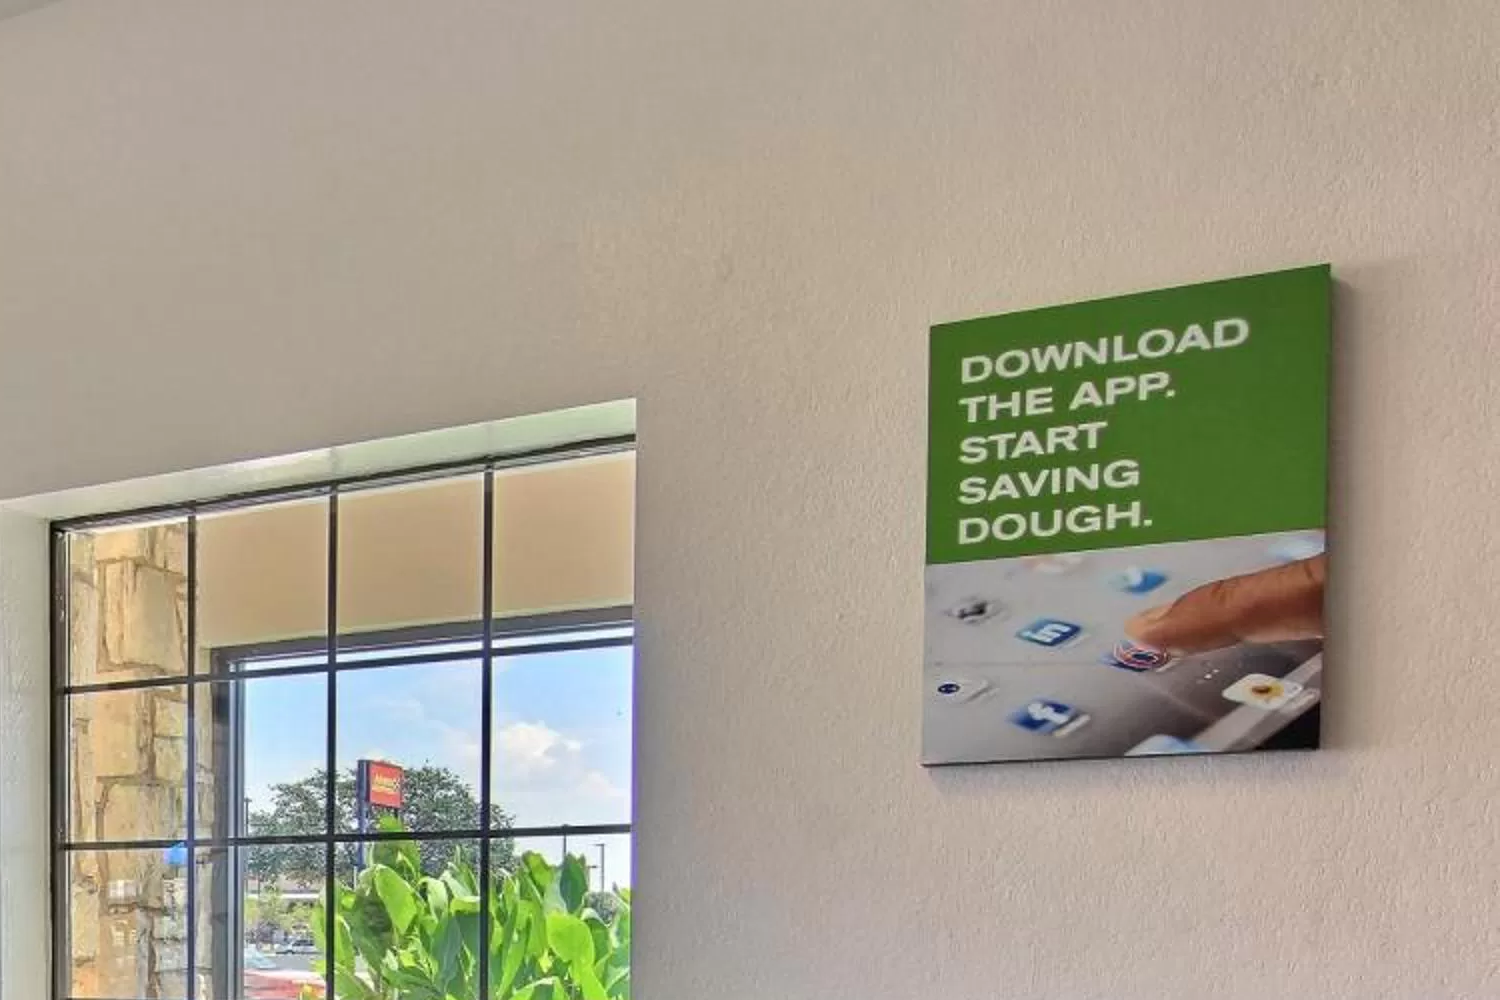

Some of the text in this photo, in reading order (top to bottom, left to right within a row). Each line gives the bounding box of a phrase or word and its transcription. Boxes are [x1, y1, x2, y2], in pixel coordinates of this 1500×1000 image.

[960, 318, 1250, 384] DOWNLOAD
[959, 371, 1176, 424] THE APP.
[959, 421, 1107, 465] START
[958, 459, 1140, 505] SAVING
[957, 501, 1153, 545] DOUGH.
